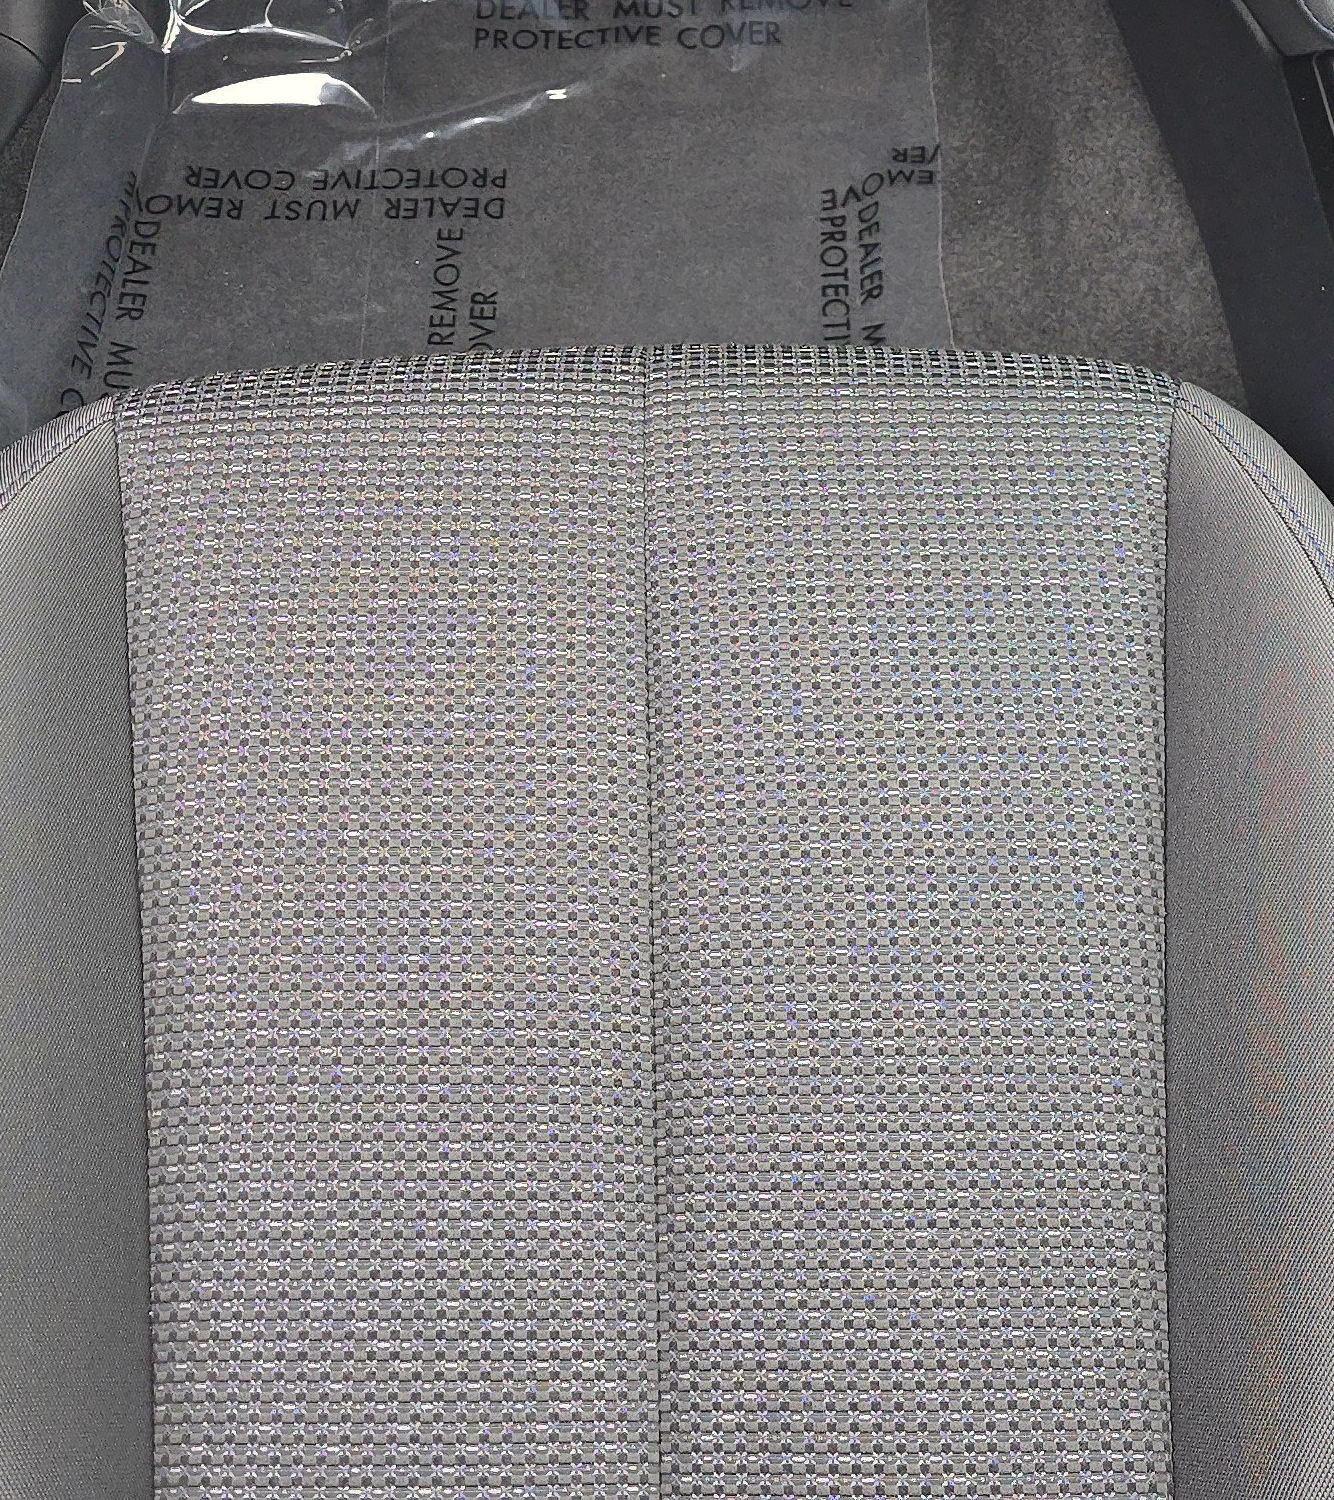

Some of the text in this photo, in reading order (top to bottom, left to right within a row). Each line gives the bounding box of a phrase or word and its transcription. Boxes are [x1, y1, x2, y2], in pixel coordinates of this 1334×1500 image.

[474, 20, 782, 50] PROTECTIVE COVER
[185, 164, 507, 192] PROTECTIVE COVER
[263, 197, 361, 221] MUST
[384, 197, 505, 220] DEALER
[115, 217, 162, 322] DEALER
[427, 227, 464, 346] REMOVE
[819, 214, 852, 346] PROTECTI
[857, 200, 885, 306] DEALER
